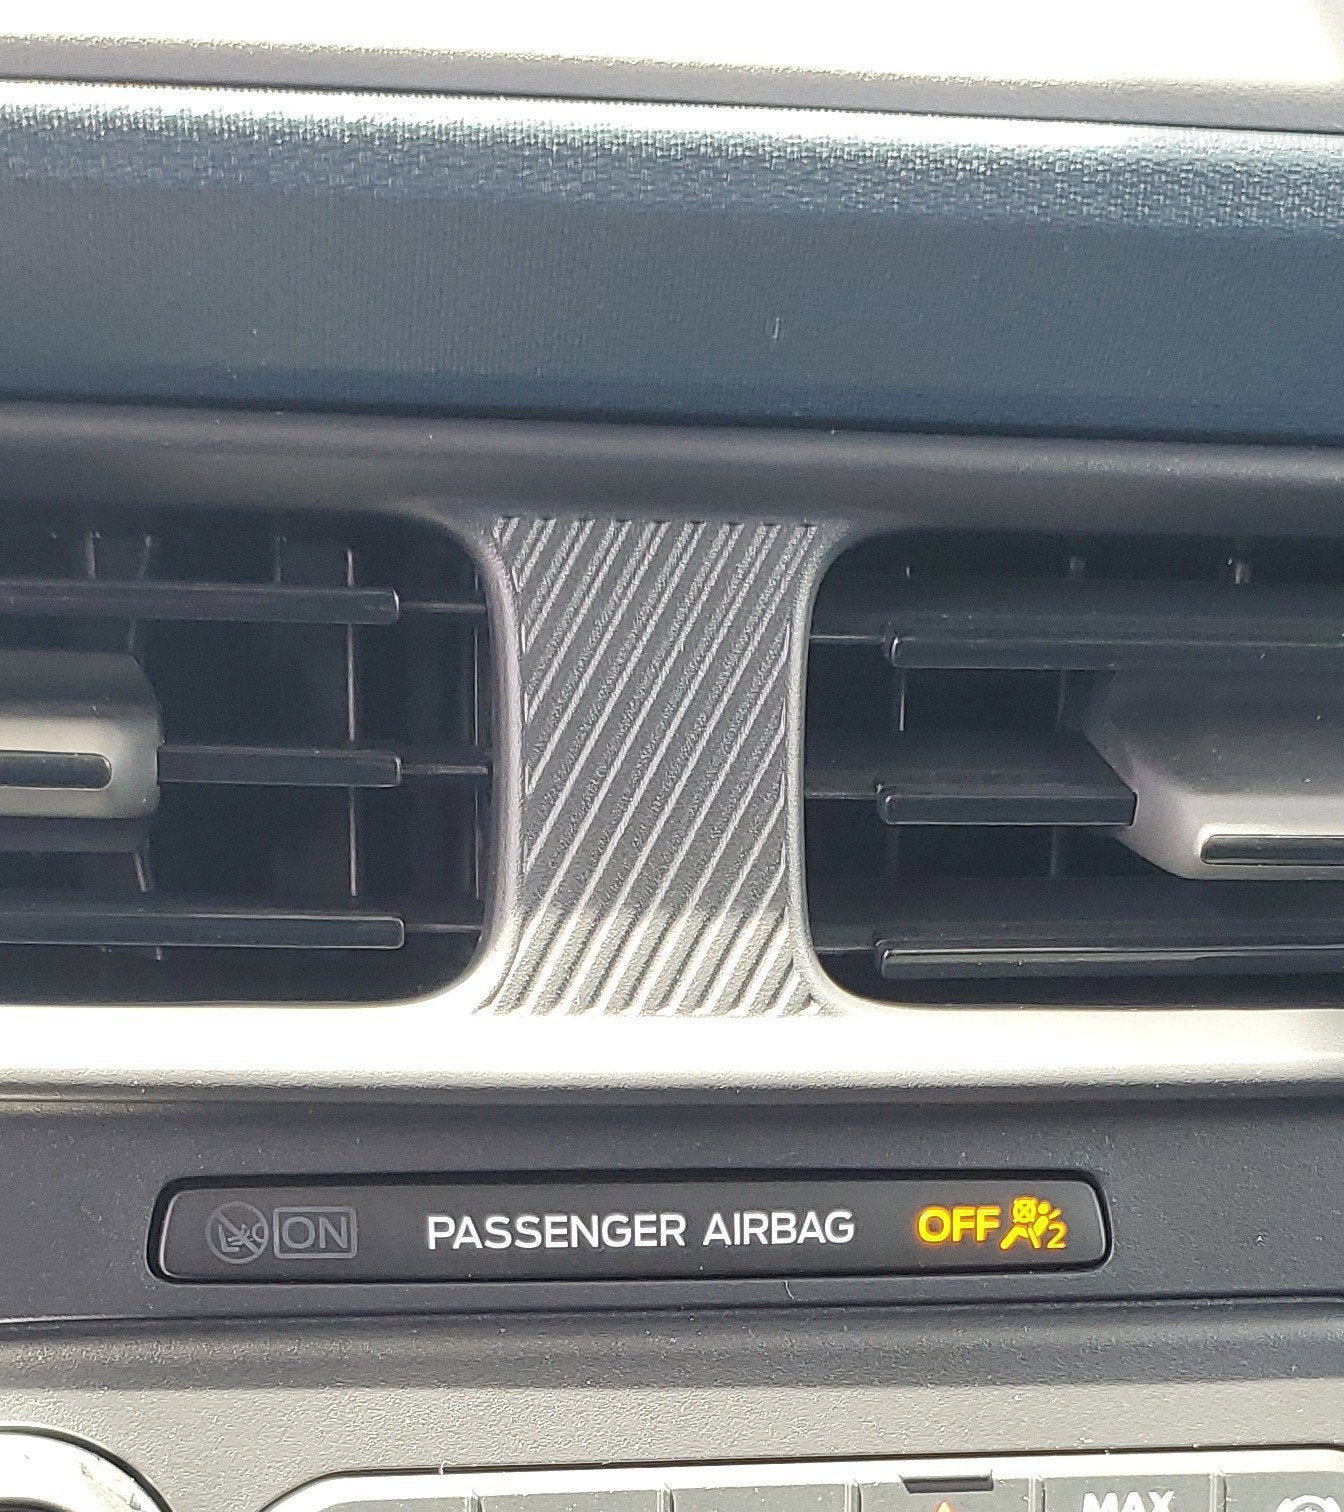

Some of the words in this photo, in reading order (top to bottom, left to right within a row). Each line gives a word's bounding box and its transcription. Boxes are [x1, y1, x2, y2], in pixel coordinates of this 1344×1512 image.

[281, 1216, 348, 1249] ON
[427, 1213, 686, 1250] PASSENGER
[702, 1210, 855, 1246] AIRBAG
[917, 1205, 1001, 1243] OFF
